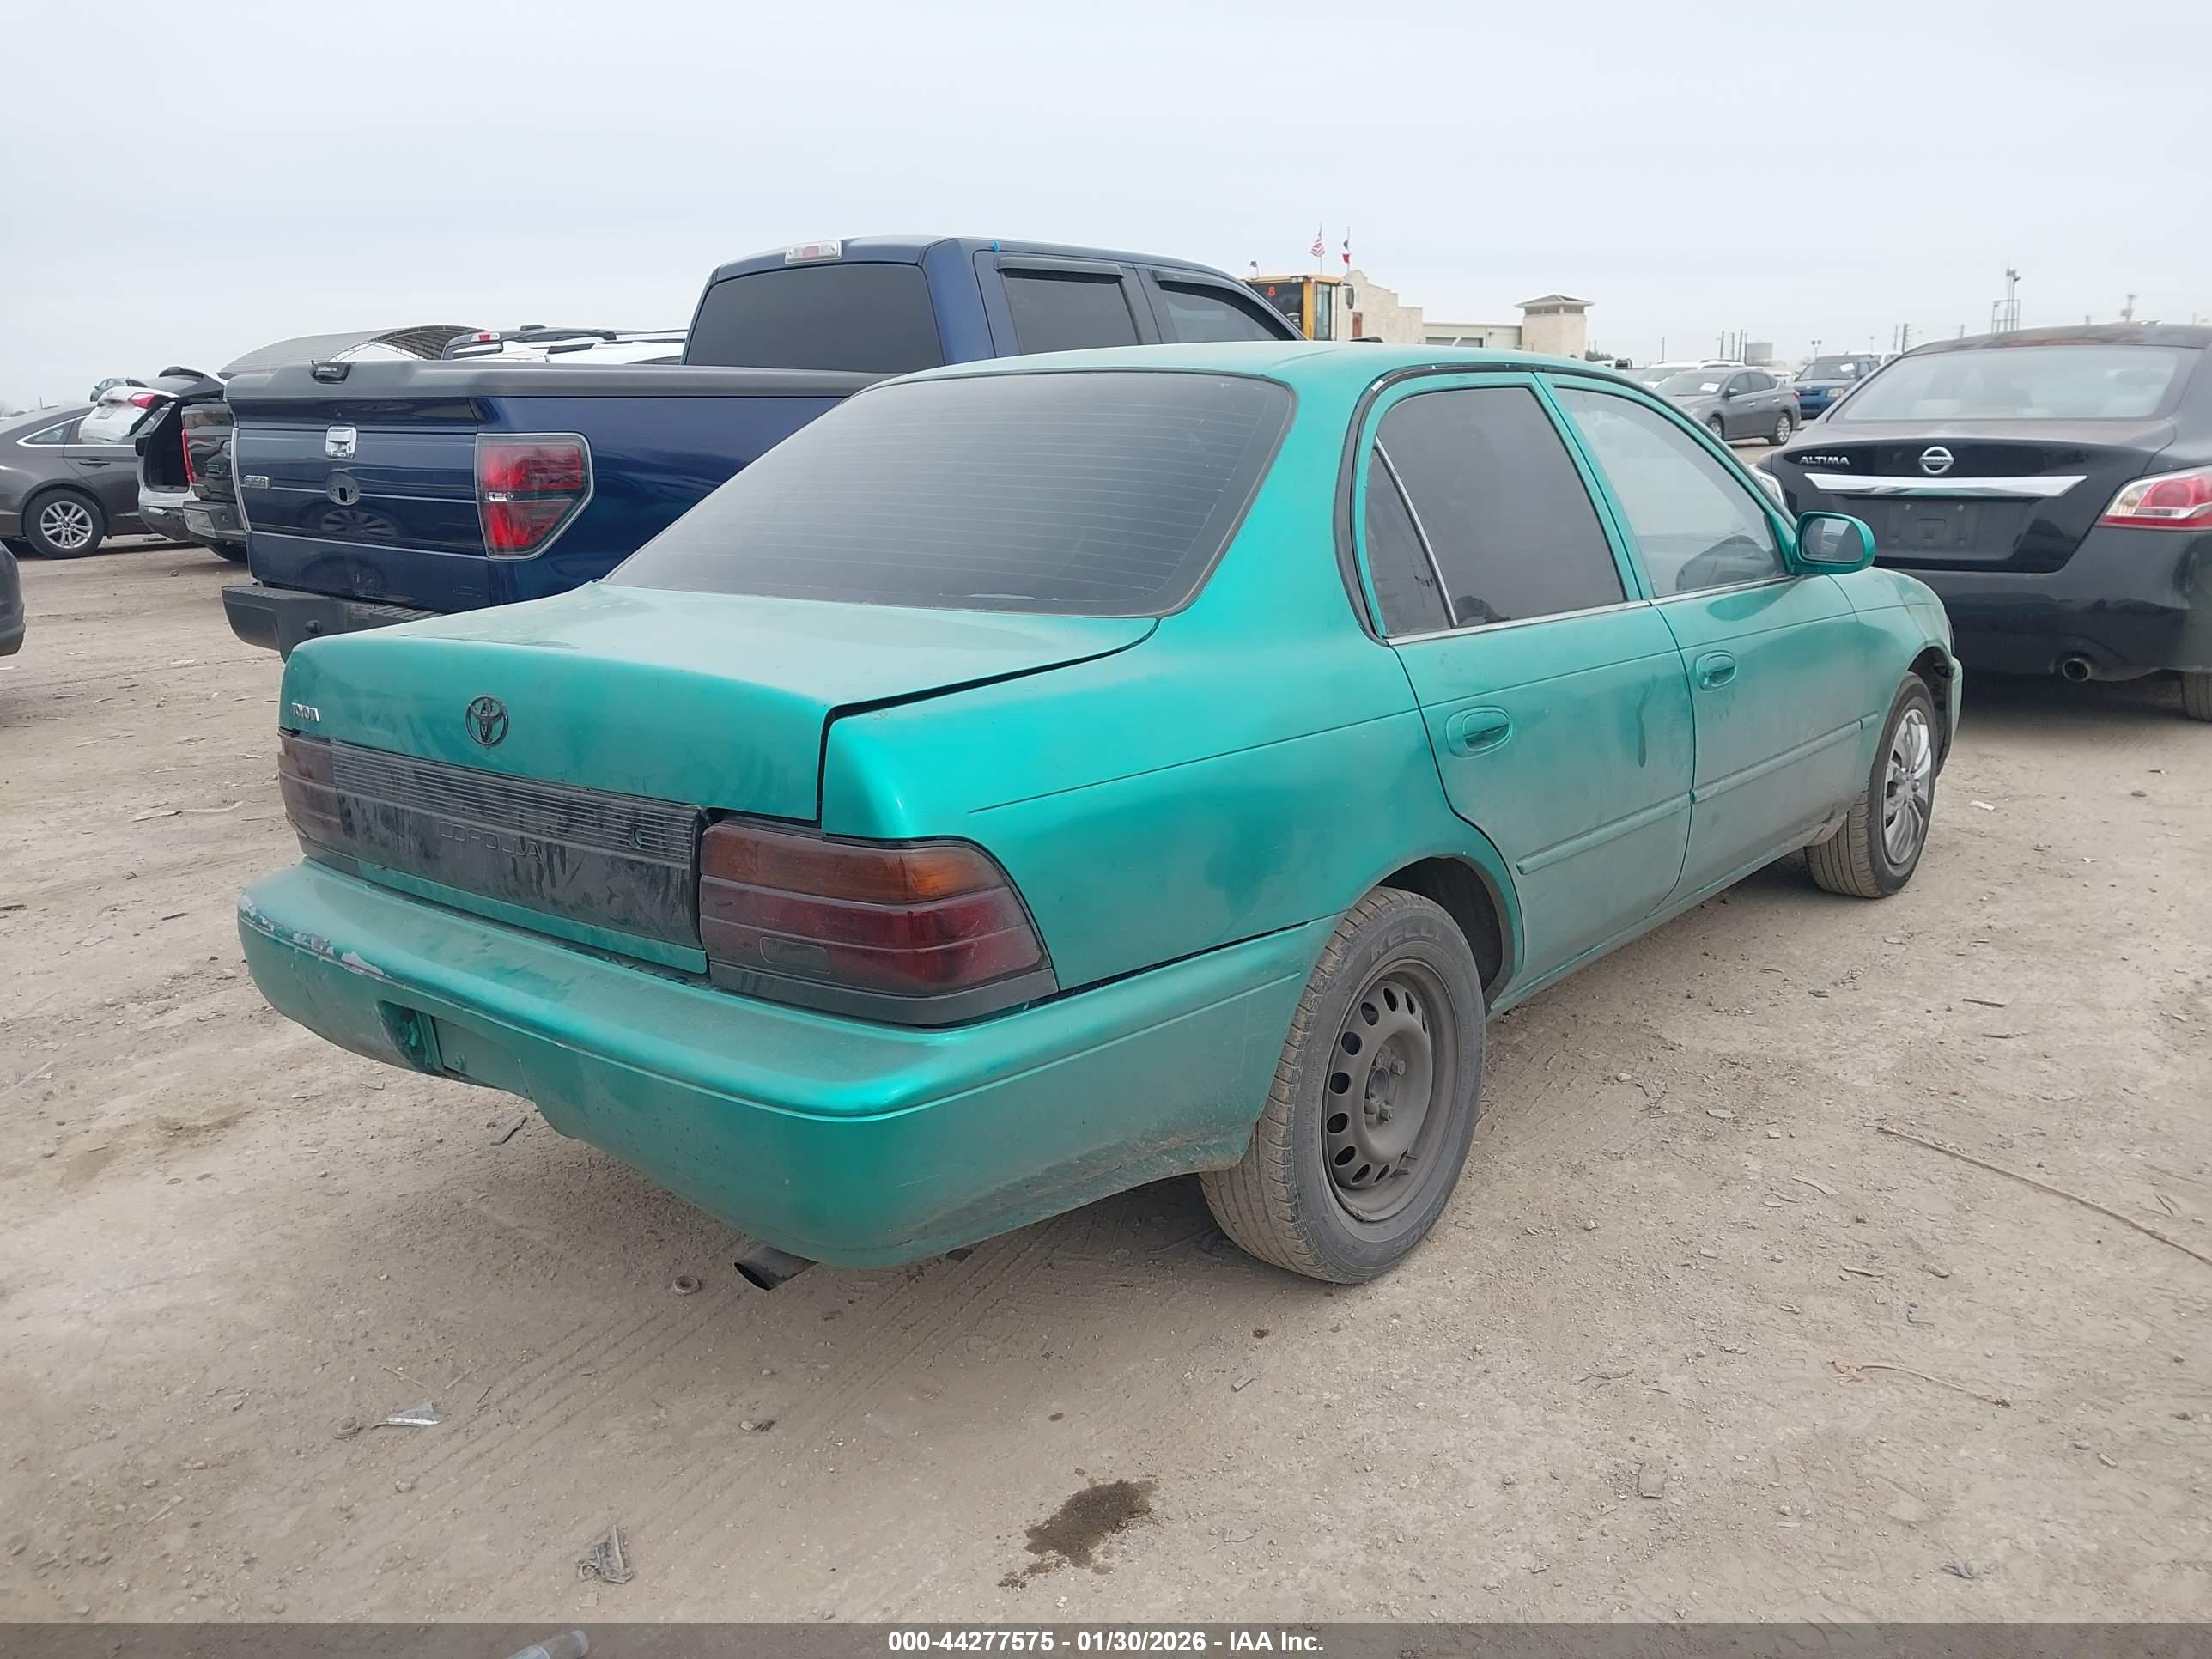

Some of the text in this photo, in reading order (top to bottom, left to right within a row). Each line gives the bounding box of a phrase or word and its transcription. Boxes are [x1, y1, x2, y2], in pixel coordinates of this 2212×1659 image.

[1800, 456, 1850, 465] ALTIMA
[291, 702, 320, 722] TOYOTA
[439, 821, 543, 862] COROLLA
